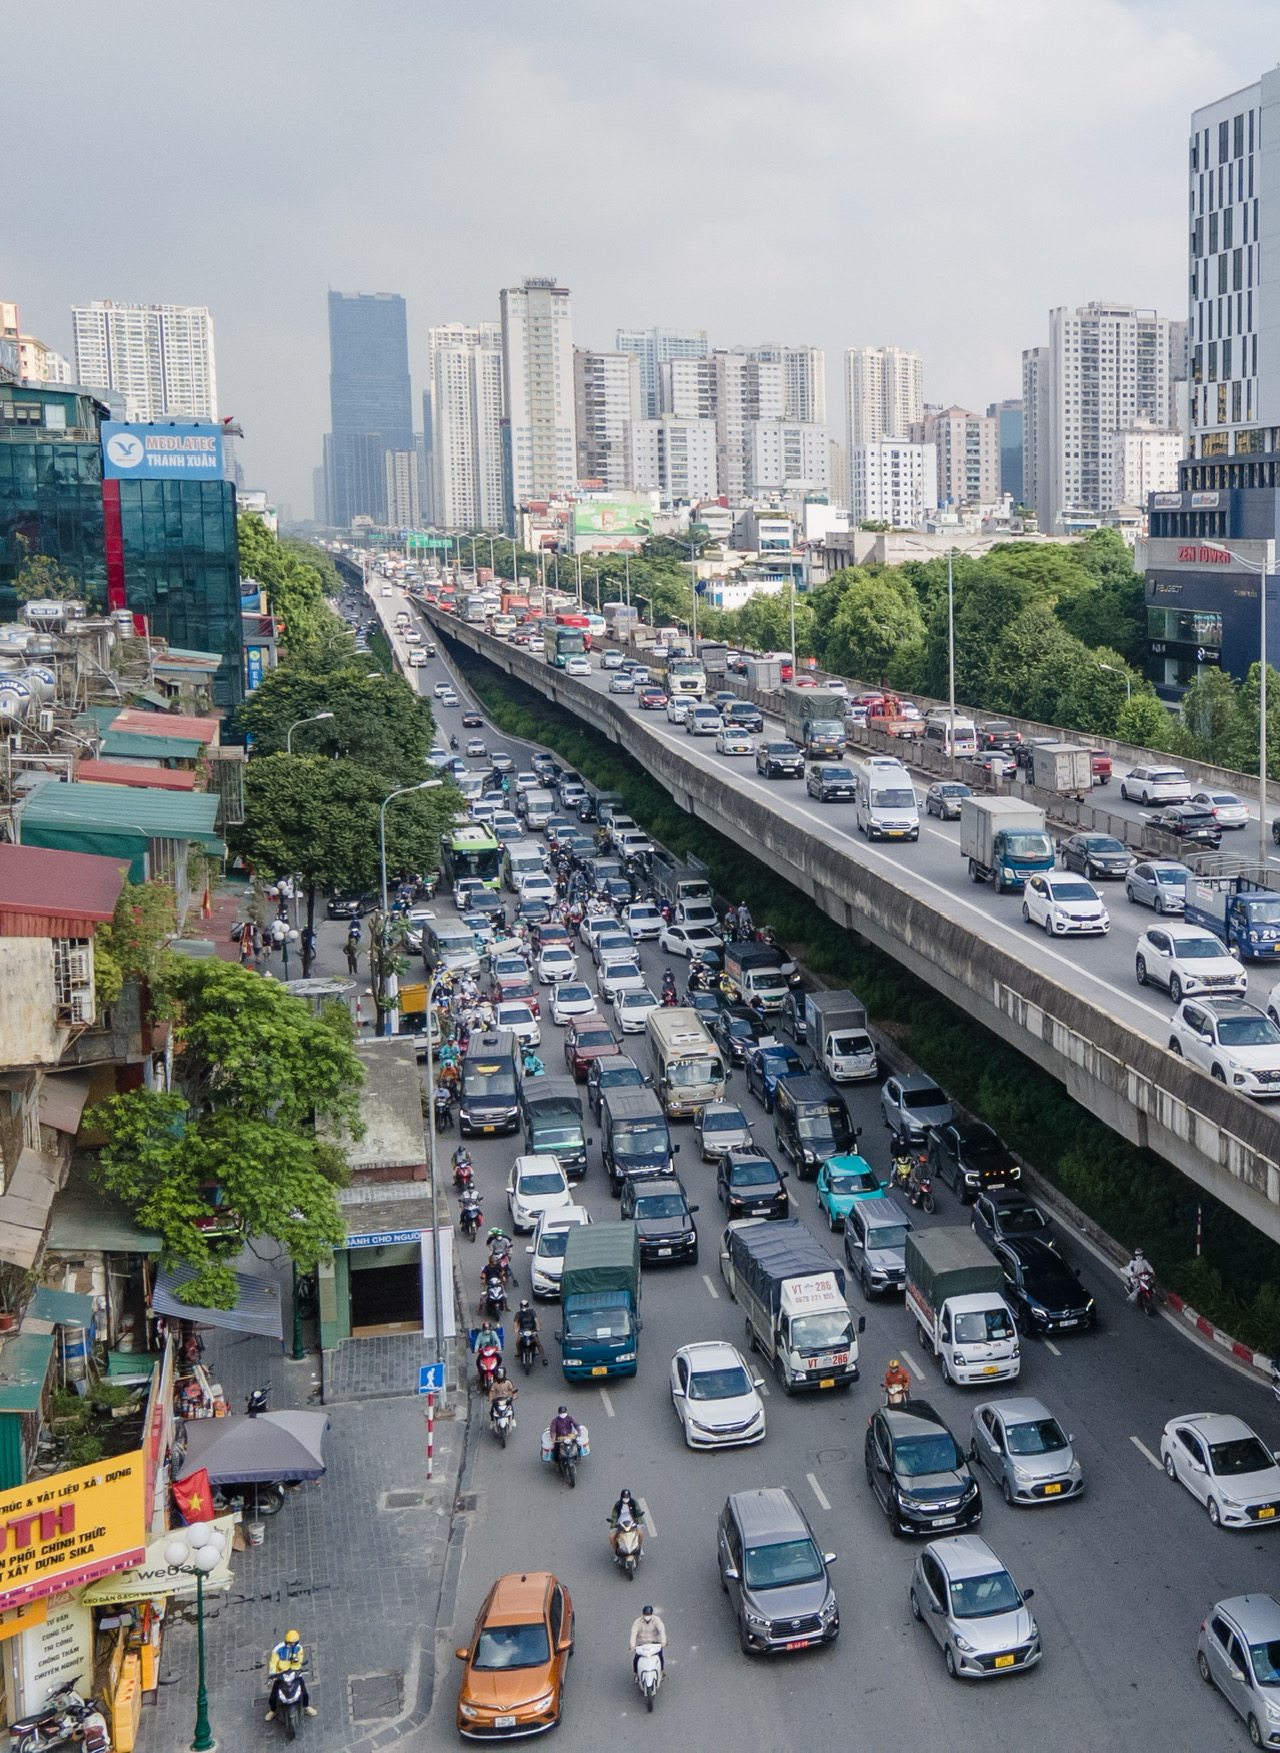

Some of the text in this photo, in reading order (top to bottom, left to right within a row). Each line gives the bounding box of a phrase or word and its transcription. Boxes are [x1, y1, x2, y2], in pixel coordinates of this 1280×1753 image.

[146, 435, 216, 451] MEDLATEC
[146, 453, 216, 467] THANH XUÂN
[1177, 546, 1195, 562] ZEN
[371, 1235, 392, 1244] CHO
[394, 1231, 421, 1241] NGƯỜ
[792, 1281, 832, 1294] VT 286
[808, 1354, 848, 1368] VT 286
[26, 1498, 33, 1507] &
[37, 1490, 55, 1503] VẬT
[58, 1484, 80, 1497] LIỆU
[105, 1467, 132, 1484] DỰNG
[9, 1546, 36, 1566] PHỐI
[41, 1538, 75, 1555] CHÍNH
[79, 1526, 107, 1543] THỨC
[7, 1563, 30, 1580] XÂY
[35, 1553, 66, 1571] DỰNG
[69, 1543, 95, 1559] SIKA
